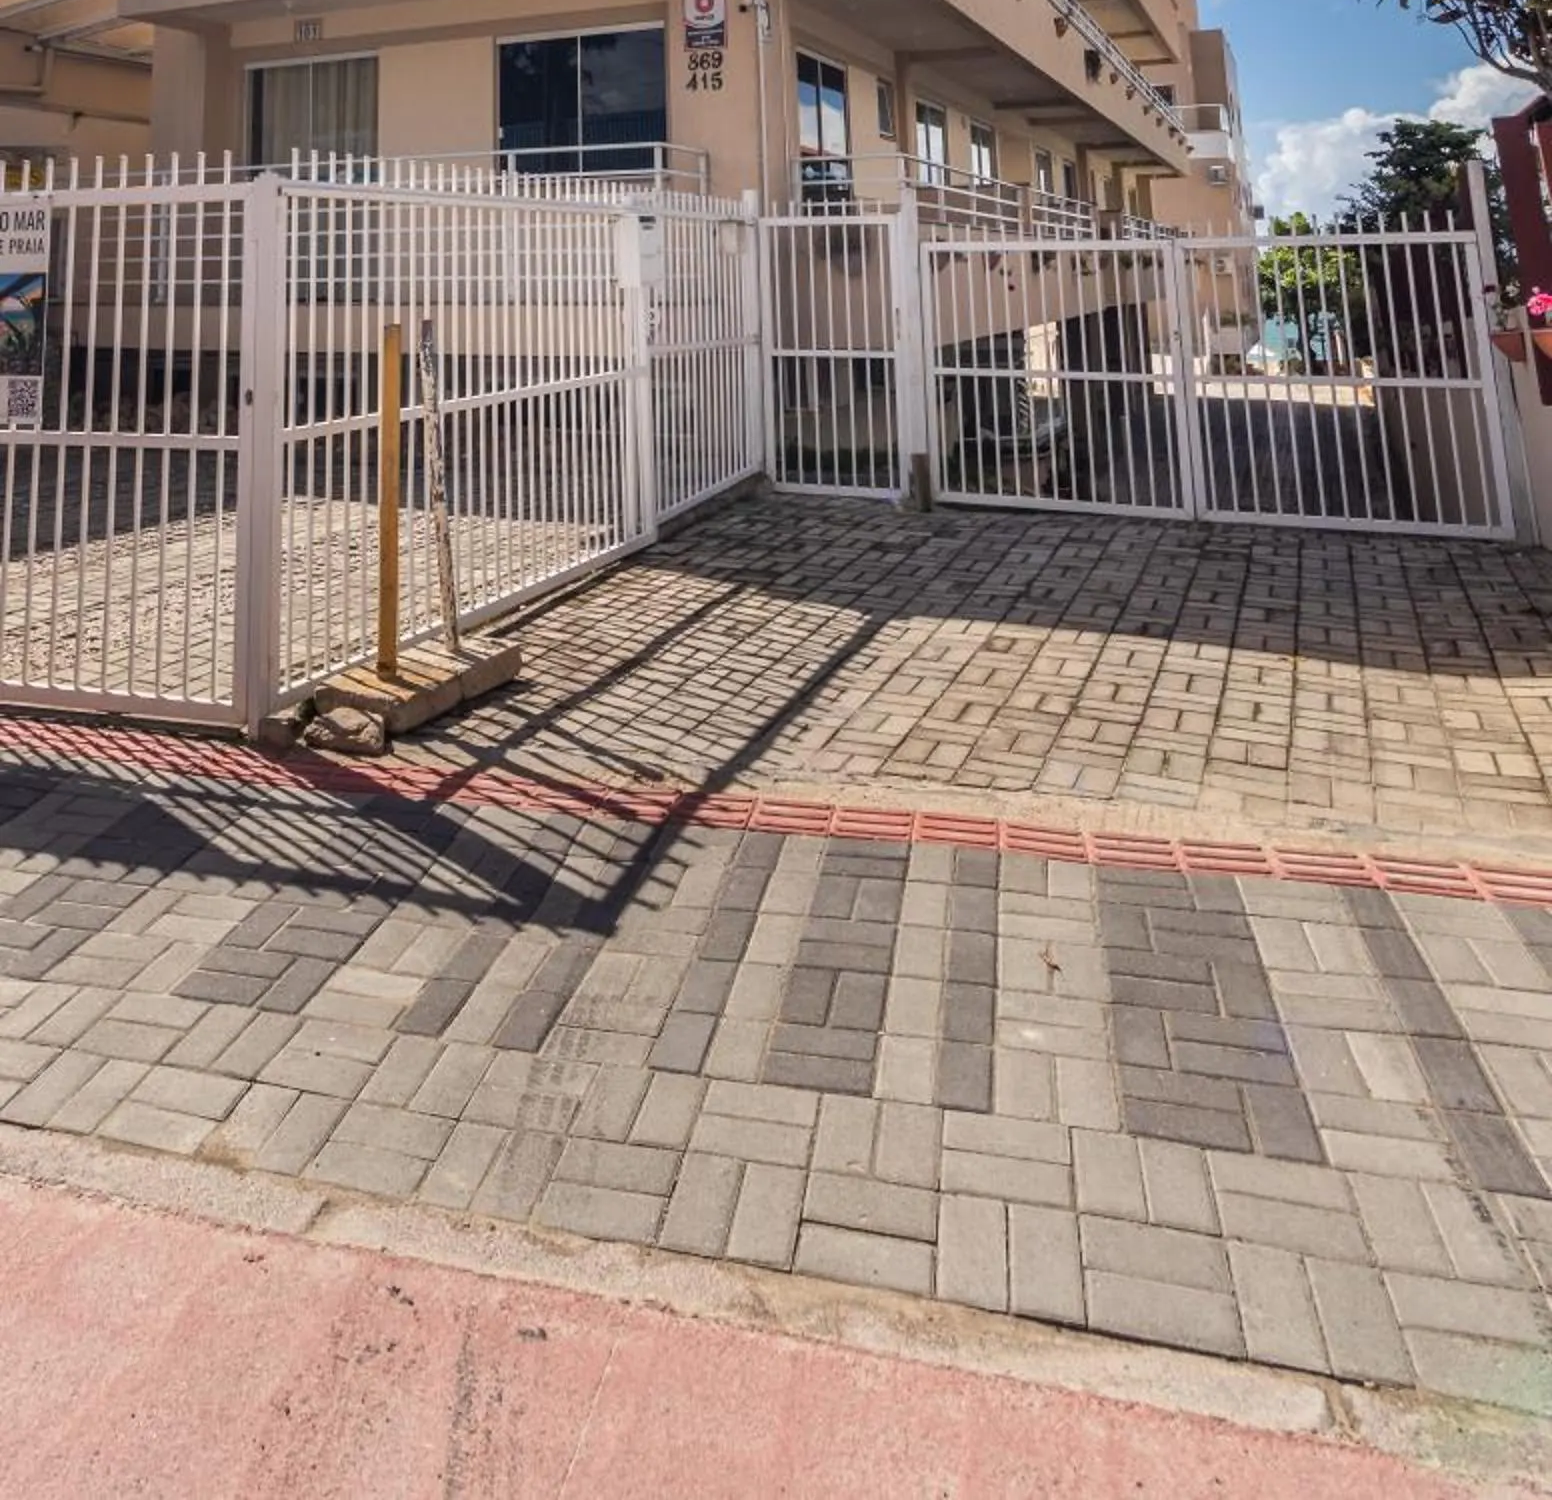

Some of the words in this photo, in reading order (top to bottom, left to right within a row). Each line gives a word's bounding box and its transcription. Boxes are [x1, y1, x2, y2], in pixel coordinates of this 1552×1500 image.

[687, 51, 723, 70] 869
[685, 71, 723, 91] 415
[14, 210, 45, 231] MAR
[9, 238, 45, 255] PRAIA
